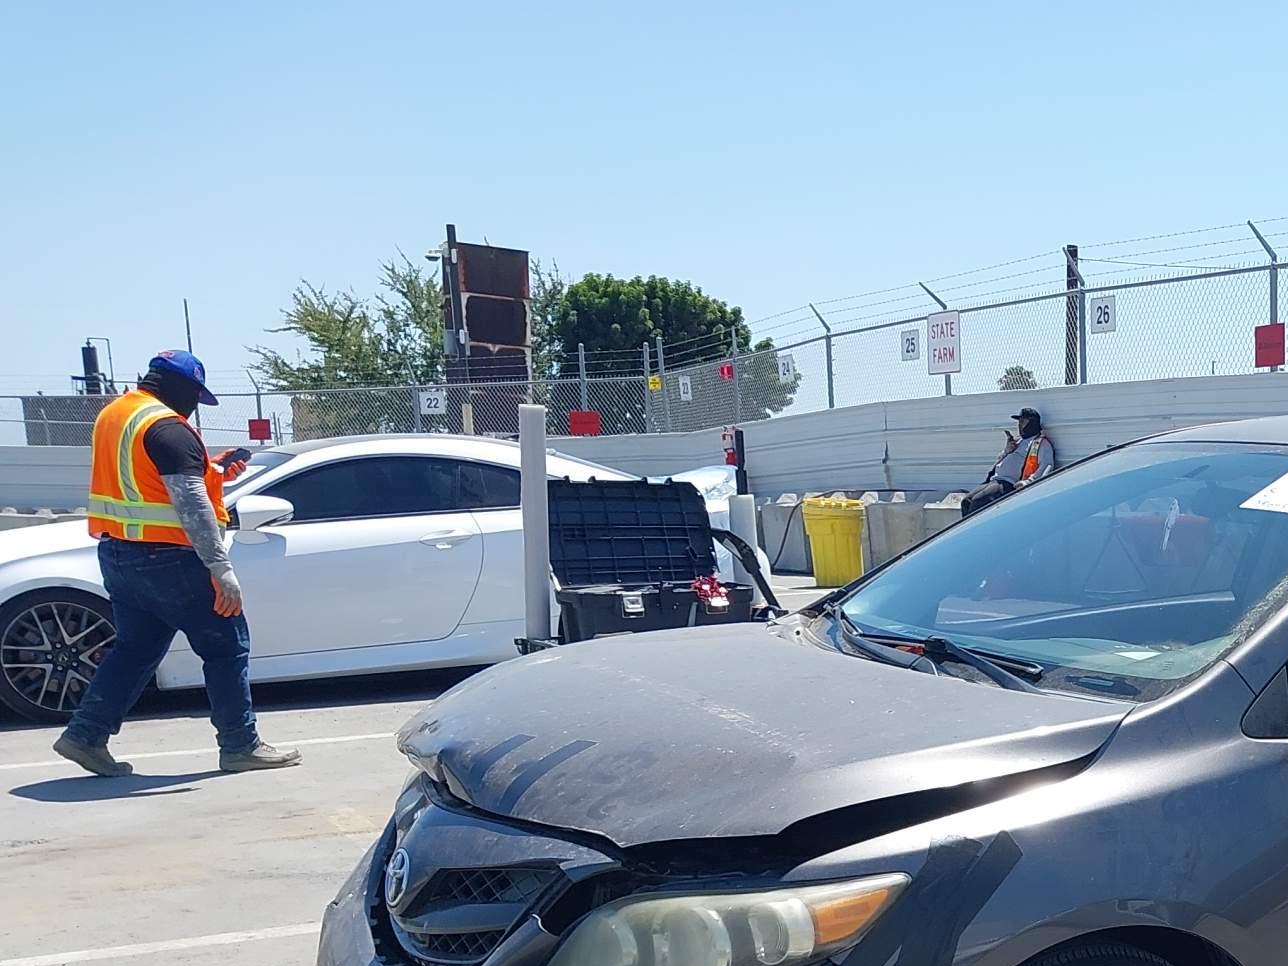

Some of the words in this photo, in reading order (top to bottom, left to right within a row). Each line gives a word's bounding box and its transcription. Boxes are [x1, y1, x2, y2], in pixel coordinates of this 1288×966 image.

[1096, 305, 1110, 324] 26
[931, 321, 955, 339] STATE
[905, 337, 916, 353] 25
[932, 346, 955, 364] FARM
[782, 361, 790, 376] 24
[426, 397, 440, 409] 22
